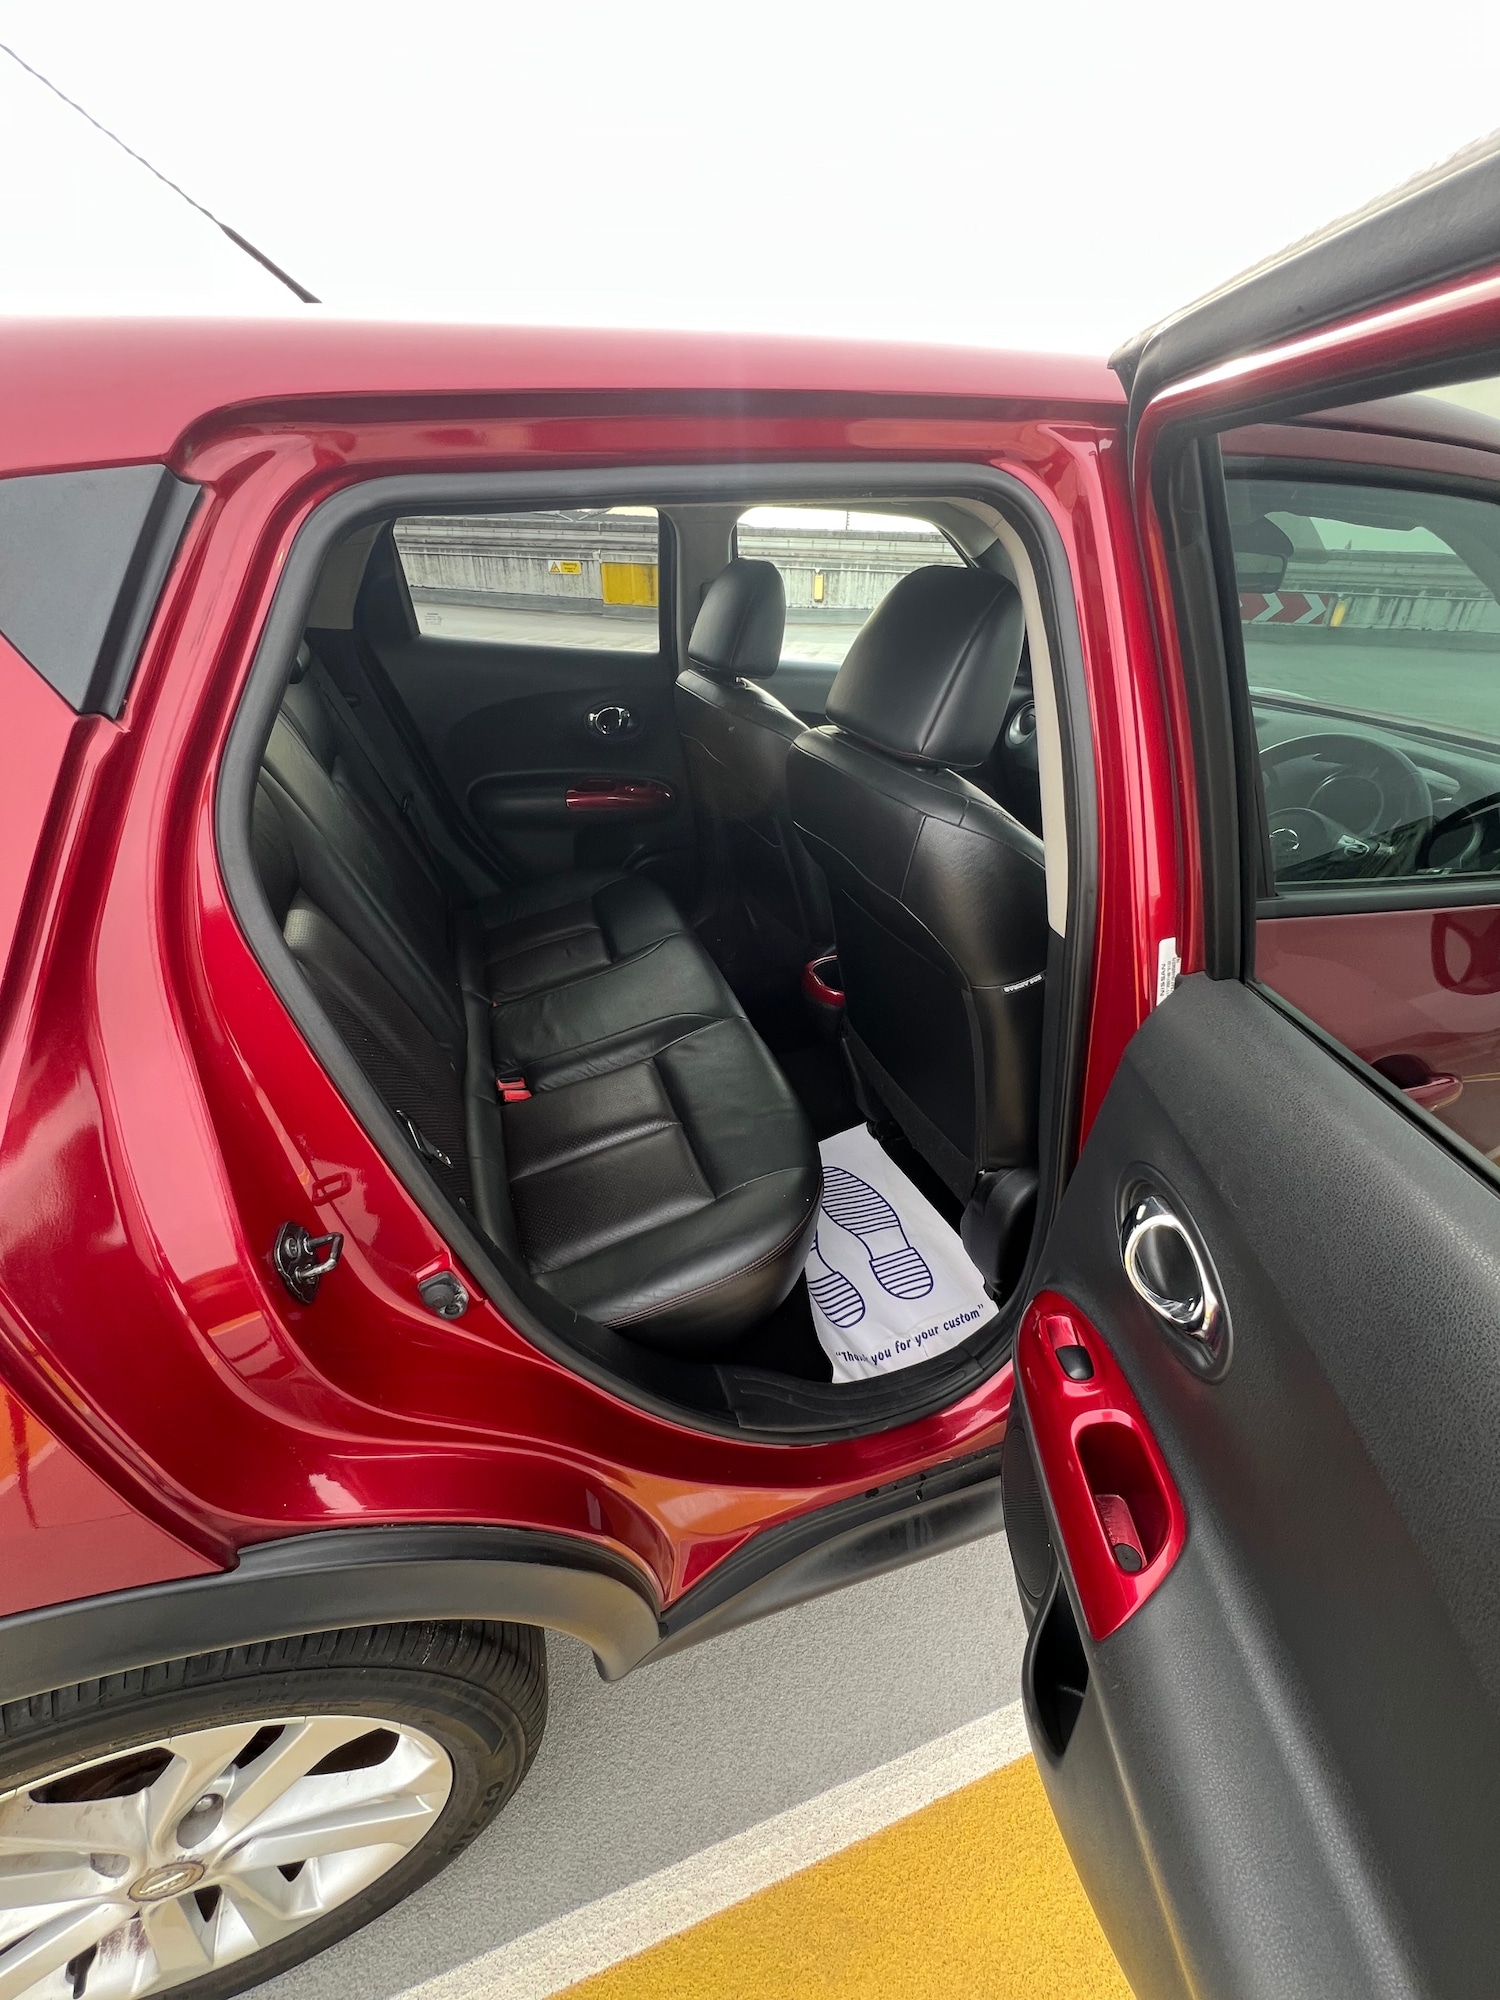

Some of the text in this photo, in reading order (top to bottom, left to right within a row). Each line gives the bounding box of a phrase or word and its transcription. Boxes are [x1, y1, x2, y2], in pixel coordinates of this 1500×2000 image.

[871, 1348, 892, 1366] you
[895, 1340, 911, 1354] for
[914, 1326, 939, 1347] your
